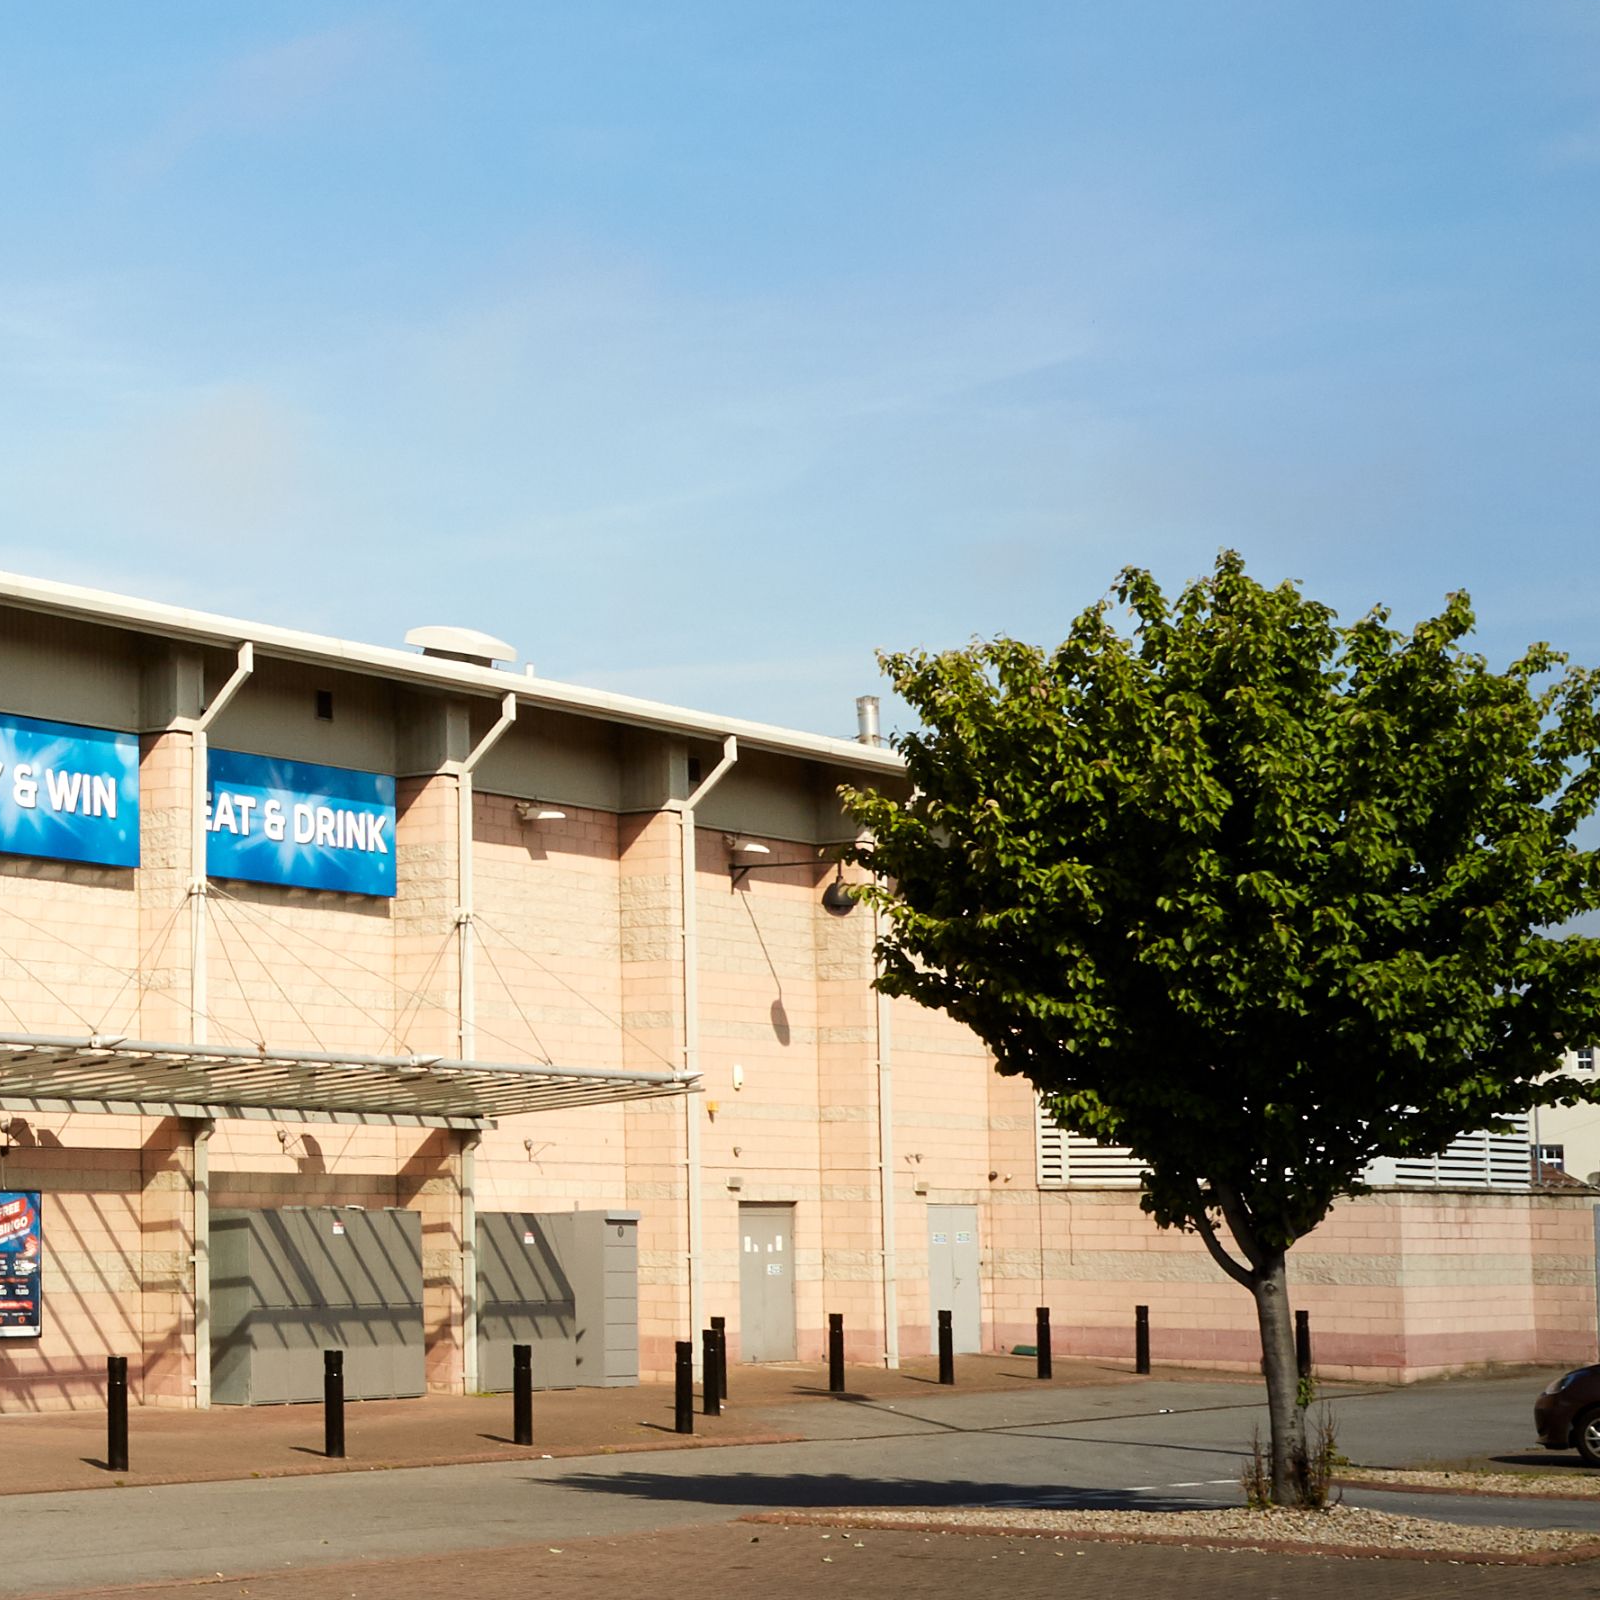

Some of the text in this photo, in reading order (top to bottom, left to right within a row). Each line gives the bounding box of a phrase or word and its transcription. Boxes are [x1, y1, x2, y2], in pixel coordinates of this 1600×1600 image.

[13, 763, 38, 809] &
[45, 768, 117, 819] WIN
[263, 799, 286, 842] &
[293, 803, 388, 854] DRINK
